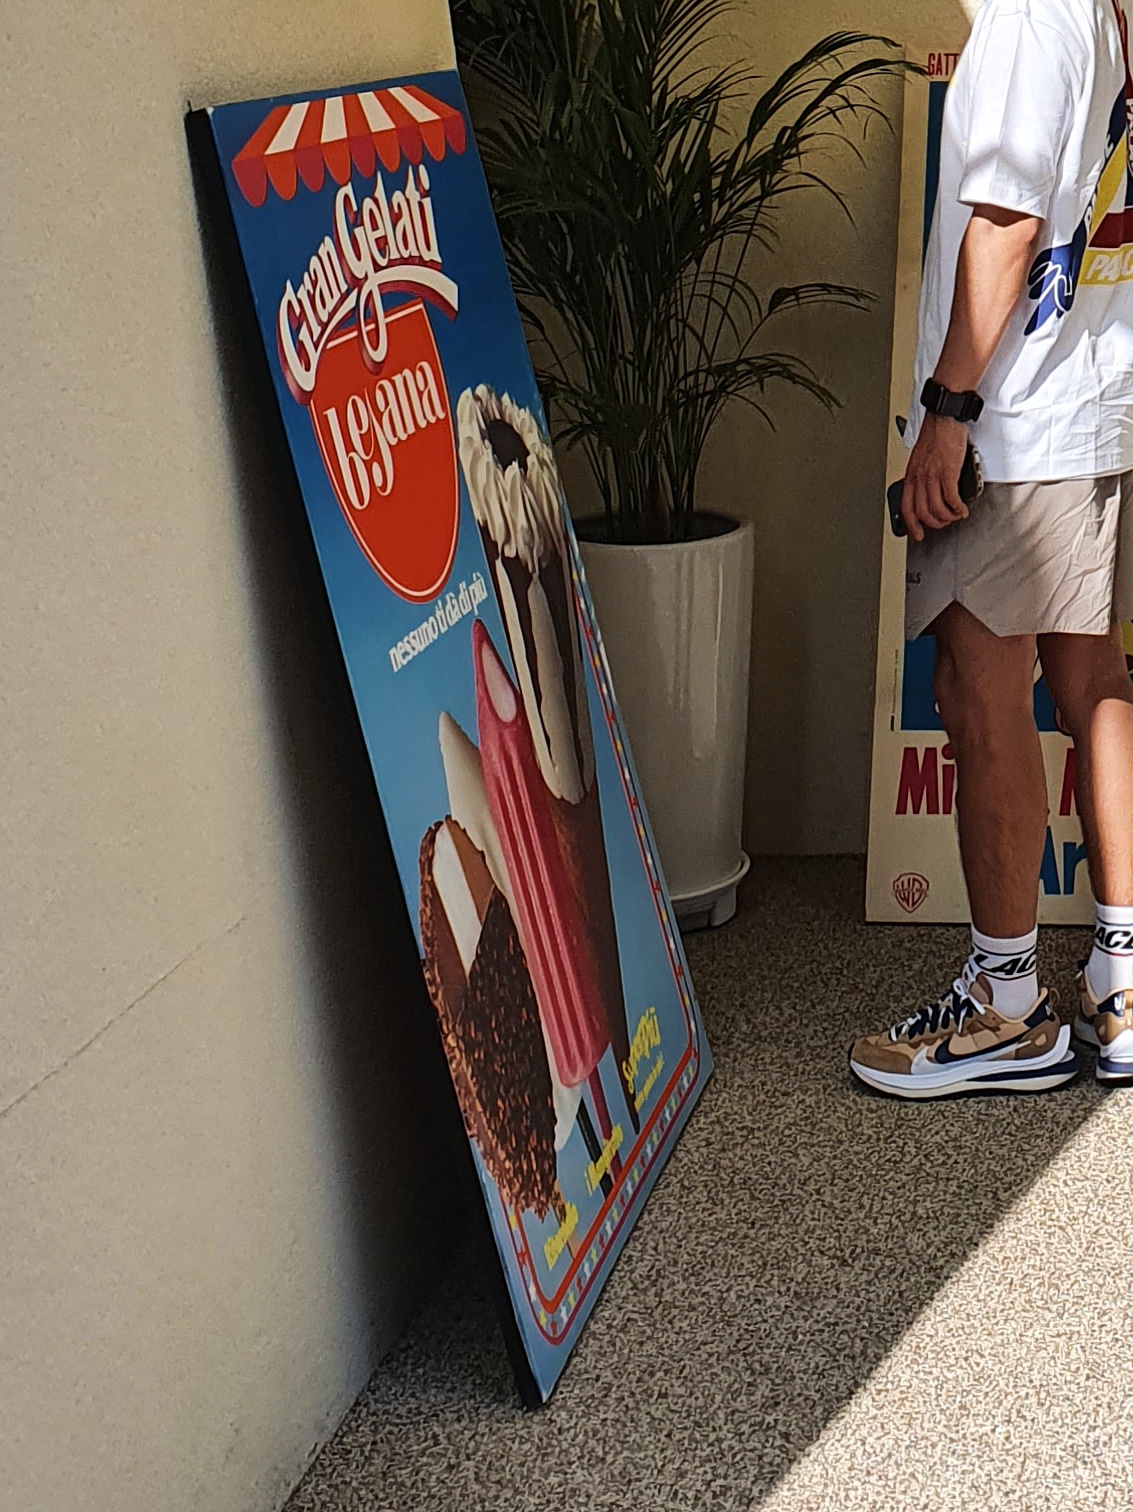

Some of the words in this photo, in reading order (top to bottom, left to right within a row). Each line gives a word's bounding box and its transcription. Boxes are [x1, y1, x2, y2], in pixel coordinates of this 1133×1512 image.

[928, 53, 960, 76] GATT
[279, 235, 350, 392] Gran
[388, 616, 438, 673] nessuno
[435, 599, 449, 634] ti
[458, 580, 472, 616] di
